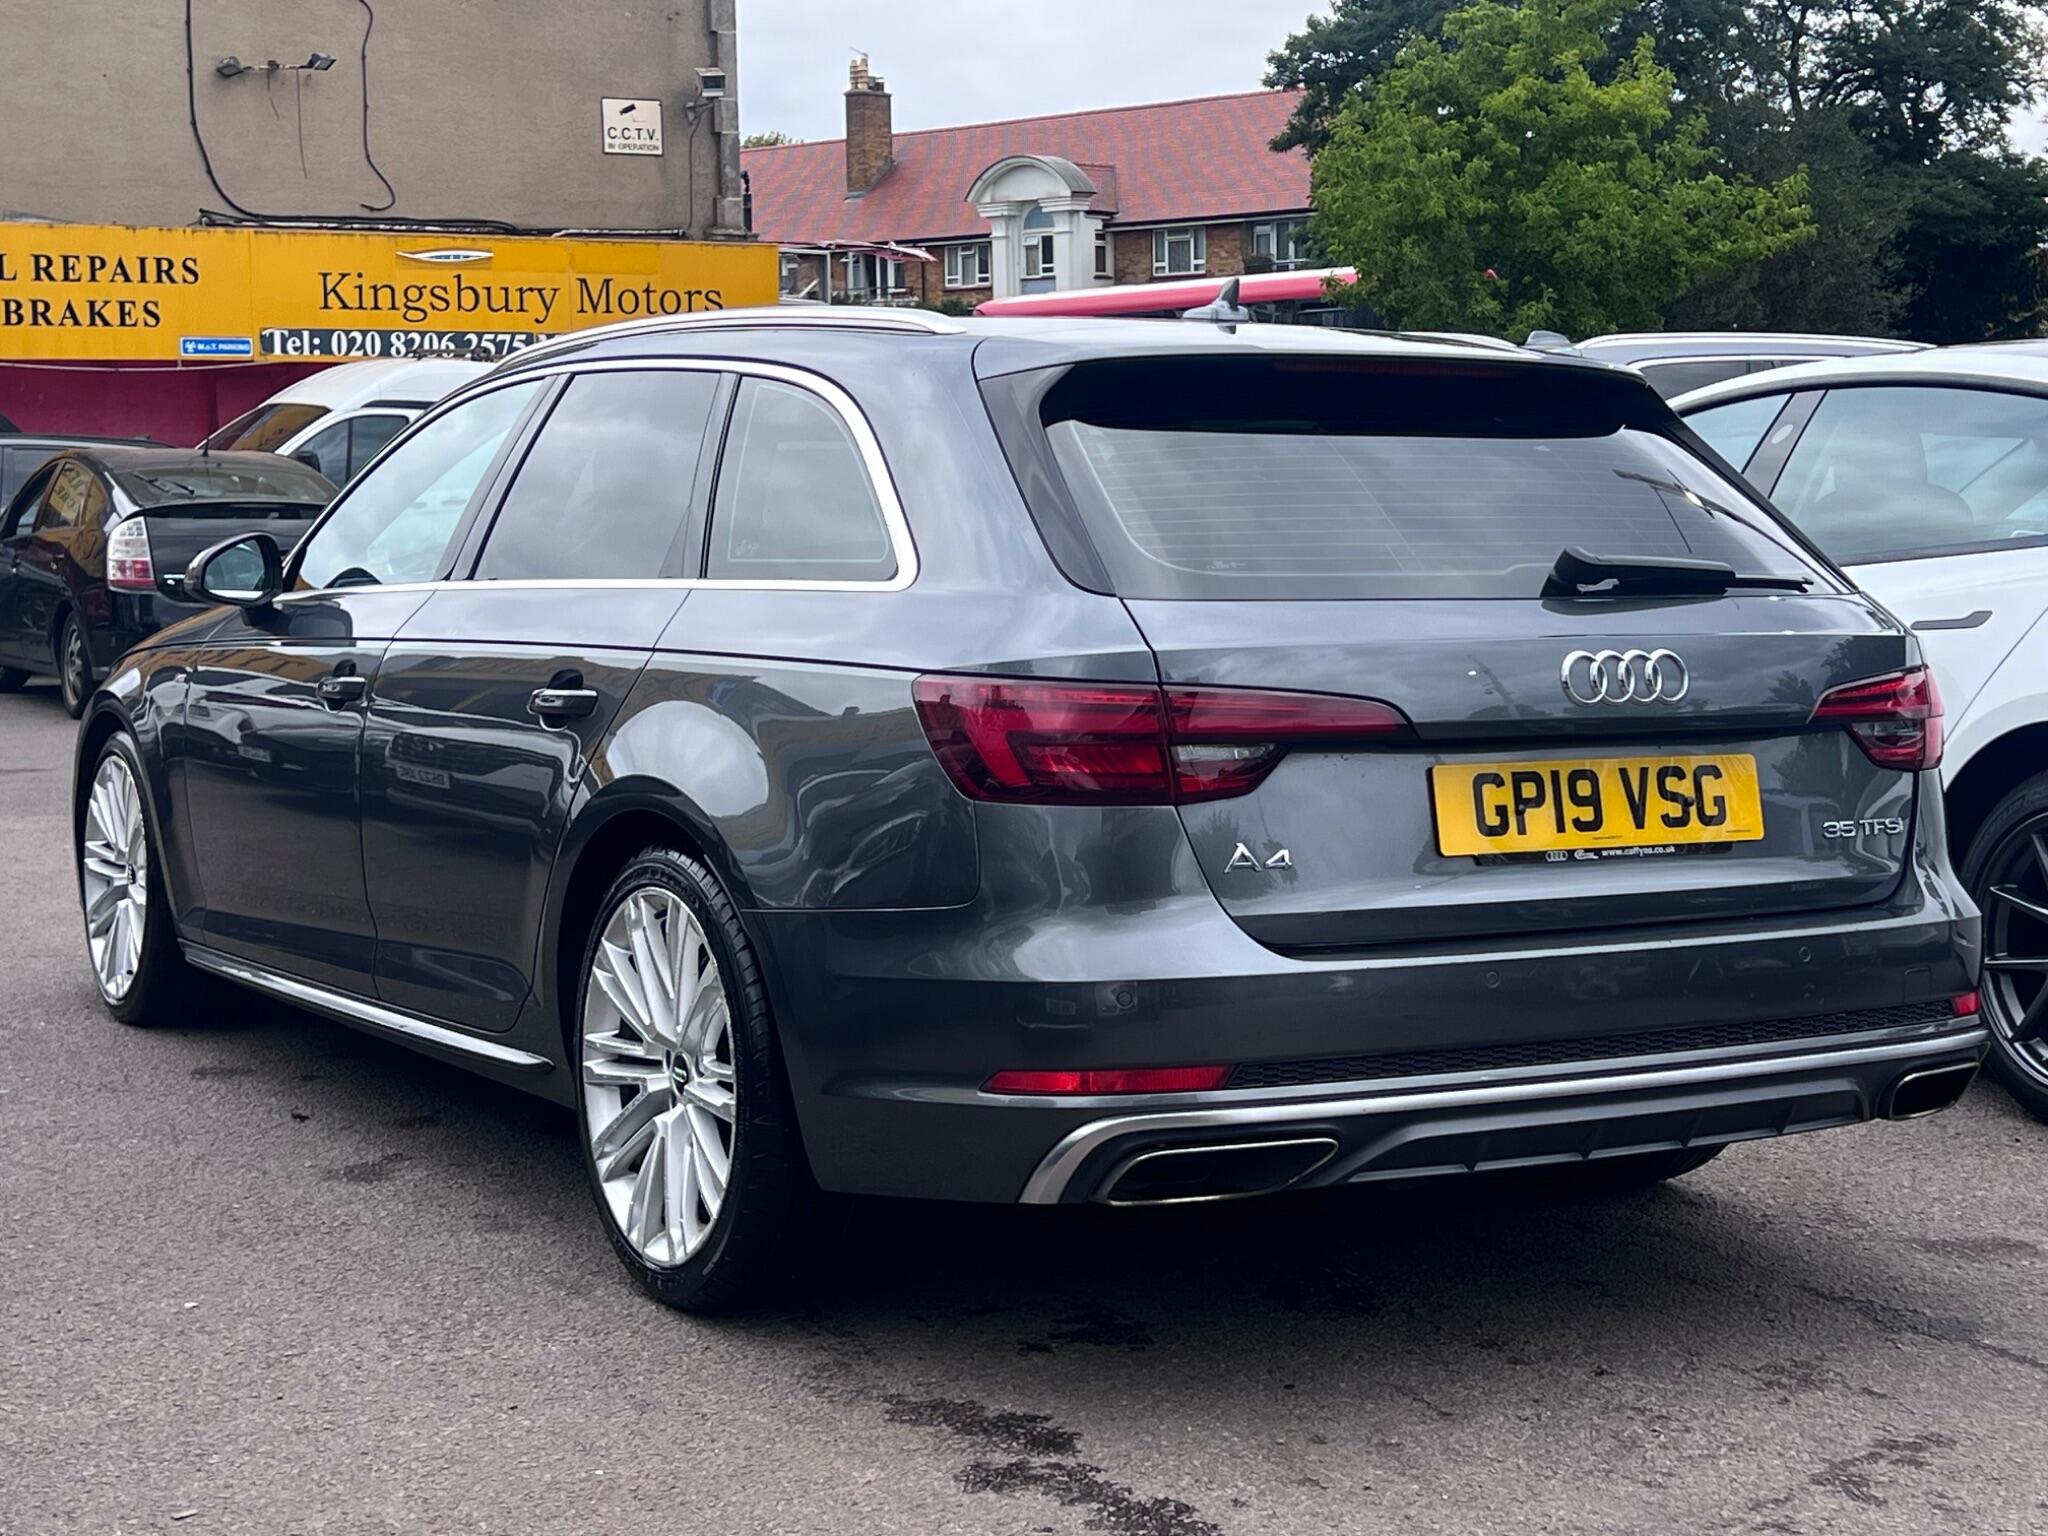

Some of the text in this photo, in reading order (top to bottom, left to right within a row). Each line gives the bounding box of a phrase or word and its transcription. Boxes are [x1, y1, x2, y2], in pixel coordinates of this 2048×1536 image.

[618, 143, 660, 151] OPERATION
[30, 253, 200, 284] REPAIRS
[1, 298, 161, 328] BRAKES
[318, 271, 724, 325] Kingsbury Motors
[261, 328, 321, 356] Tel:
[330, 330, 382, 357] 020
[389, 331, 457, 358] 8206
[1472, 764, 1727, 837] GP19 VSG
[1822, 817, 1904, 838] 35 TFSI
[1223, 842, 1293, 874] A4
